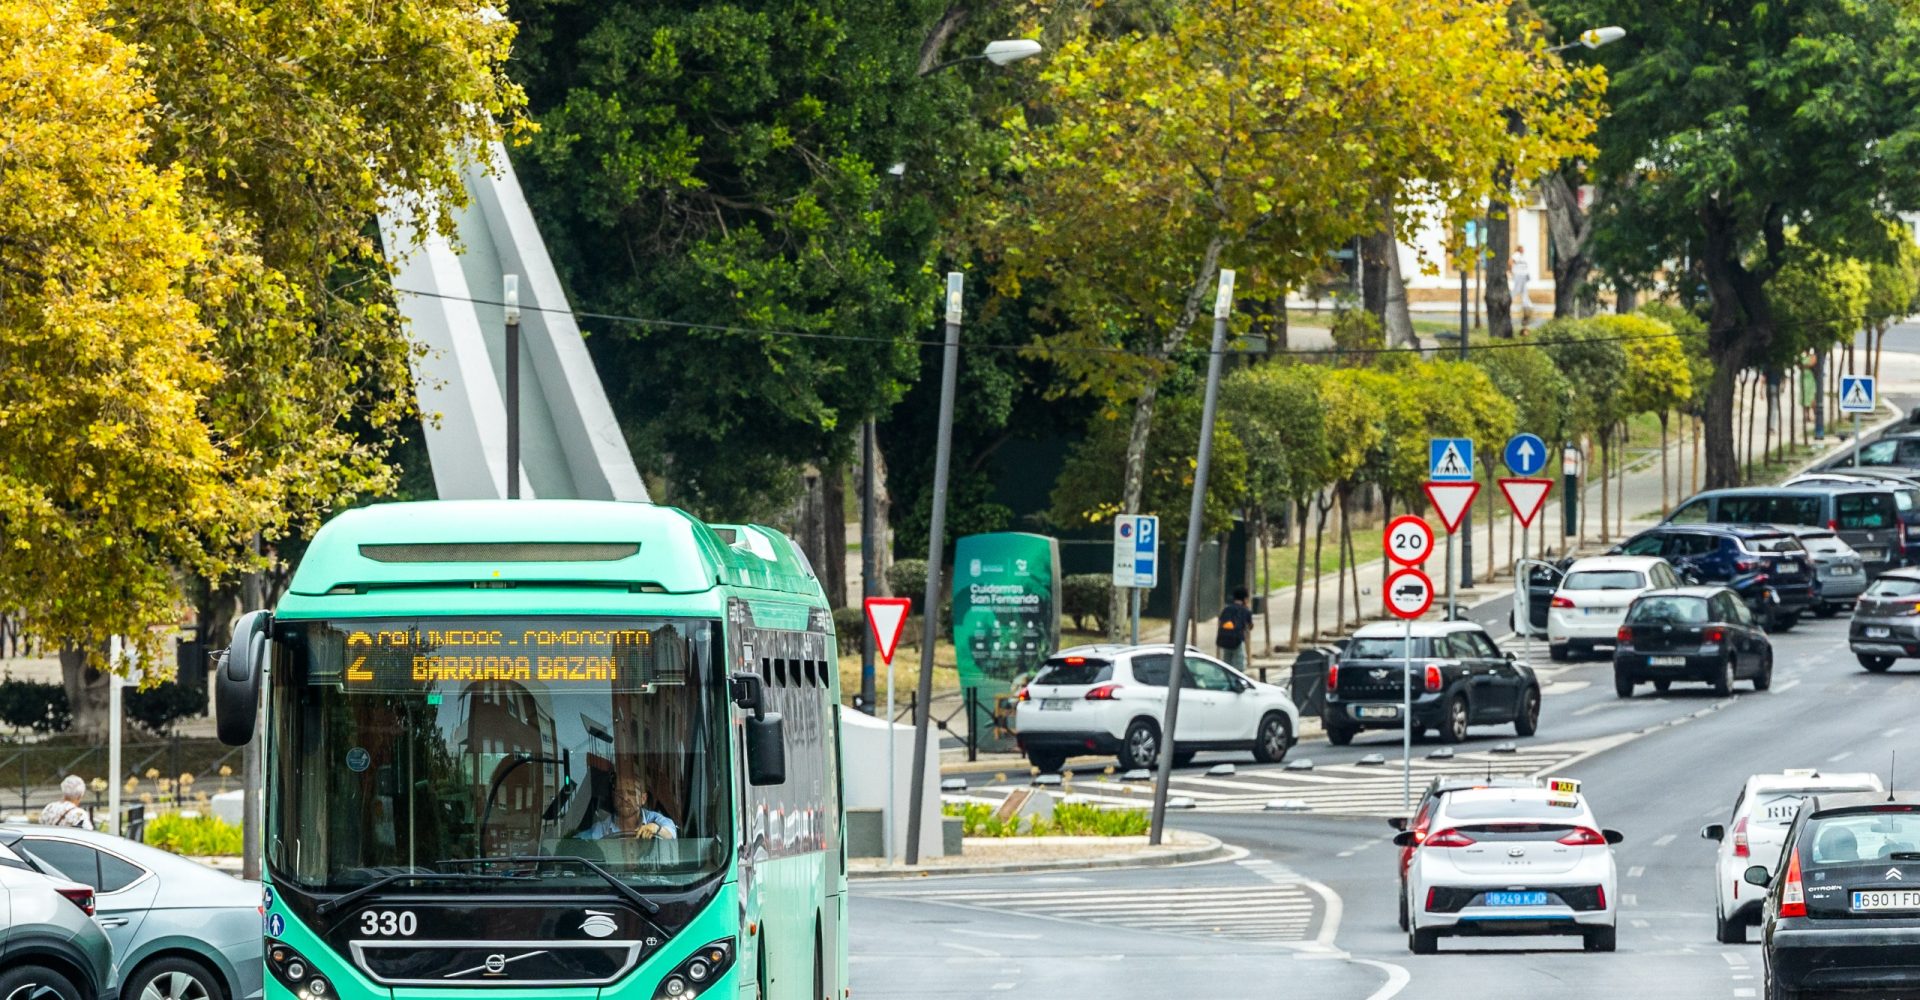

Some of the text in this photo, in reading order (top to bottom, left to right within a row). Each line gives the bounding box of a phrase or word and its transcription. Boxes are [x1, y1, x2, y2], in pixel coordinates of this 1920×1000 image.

[1139, 519, 1152, 544] P
[1395, 533, 1422, 549] 20
[970, 593, 1039, 604] San Fernando
[412, 656, 617, 680] BARRIADA BAZAN
[1862, 892, 1920, 907] 6901 FD
[360, 910, 418, 936] 330
